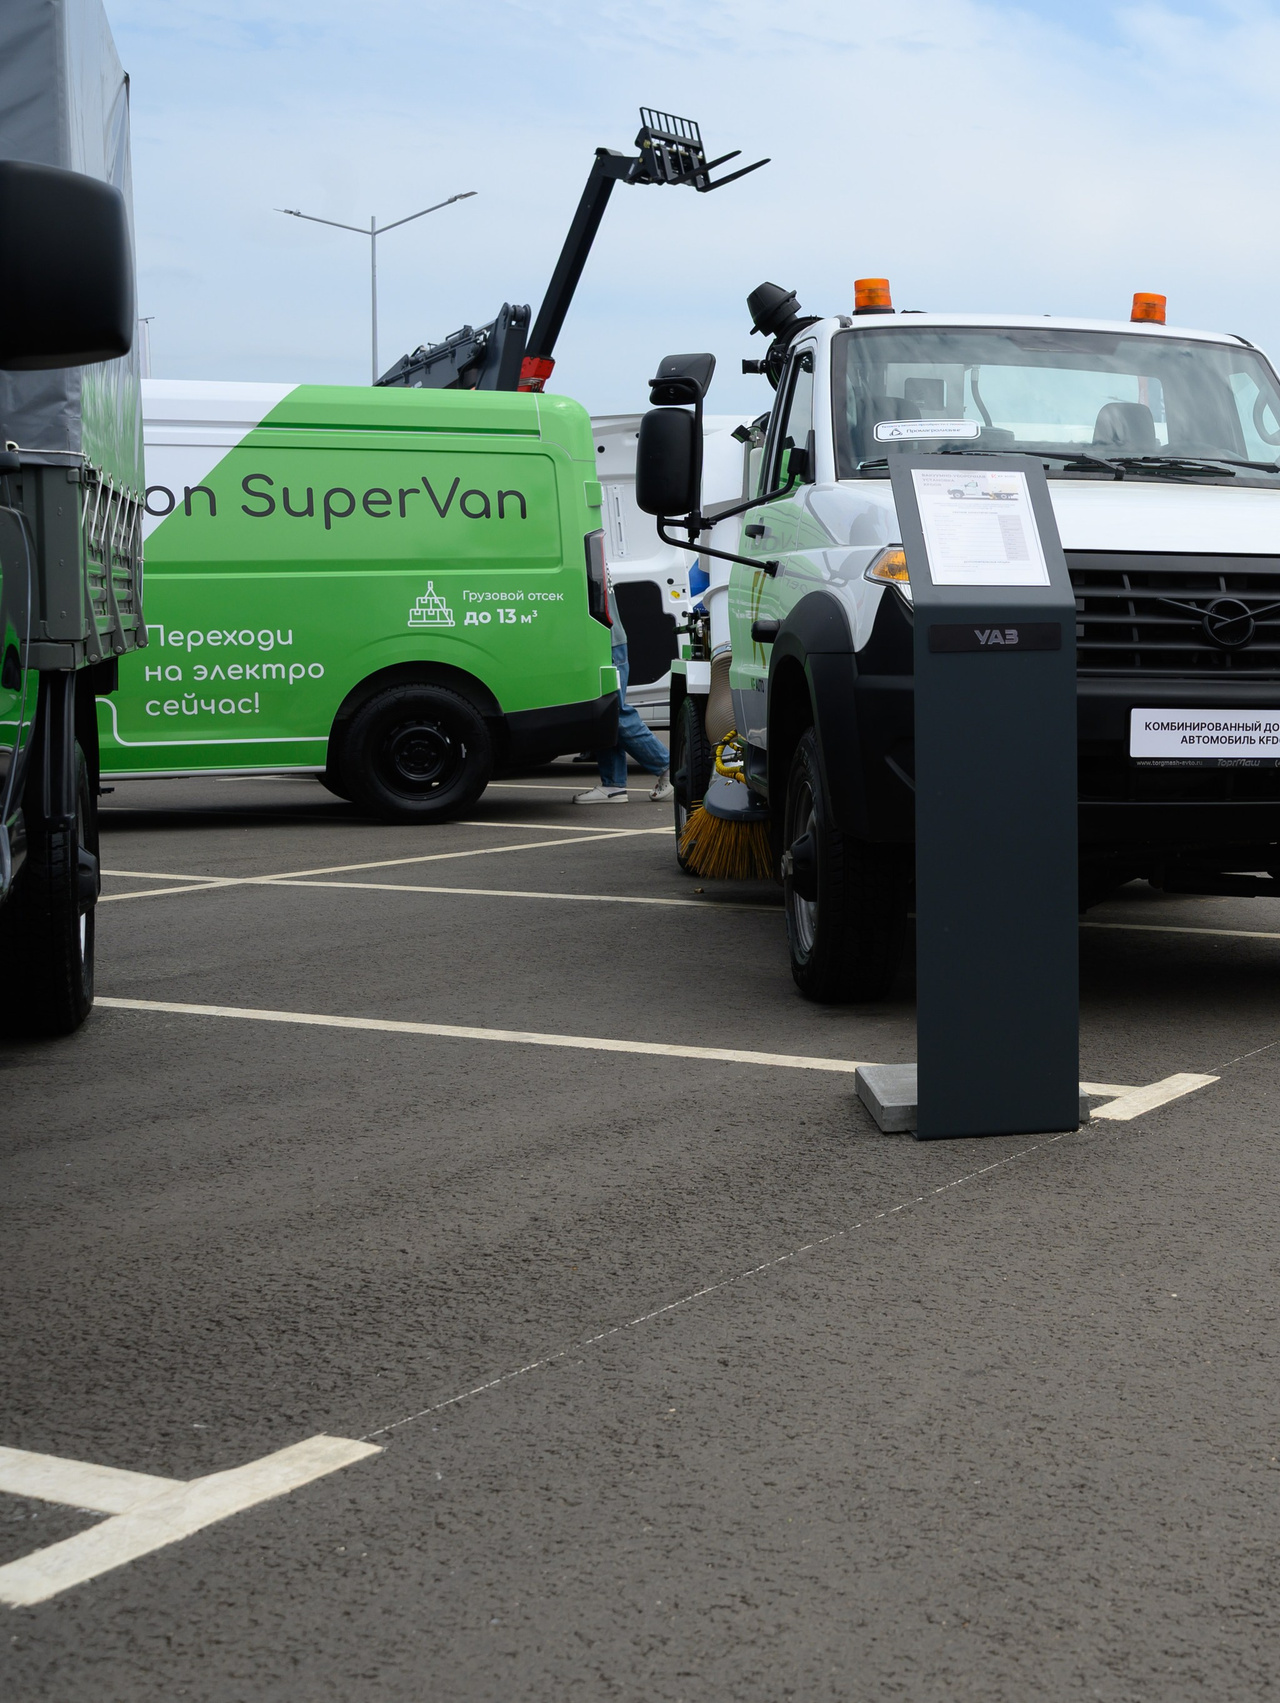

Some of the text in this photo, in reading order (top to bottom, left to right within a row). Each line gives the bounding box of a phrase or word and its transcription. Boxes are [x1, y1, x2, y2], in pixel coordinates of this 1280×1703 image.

[241, 473, 528, 531] SuperVan
[462, 590, 564, 603] Грузовой отсек
[464, 611, 492, 626] до
[496, 608, 517, 624] 13
[146, 624, 293, 653] Переходи
[974, 629, 1019, 645] УАЗ
[145, 662, 325, 685] на электро
[145, 691, 260, 716] сейчас!
[1144, 720, 1262, 732] КОМБИНИРОВАННЫЙ
[1180, 735, 1256, 745] АВТОМОБИЛЬ
